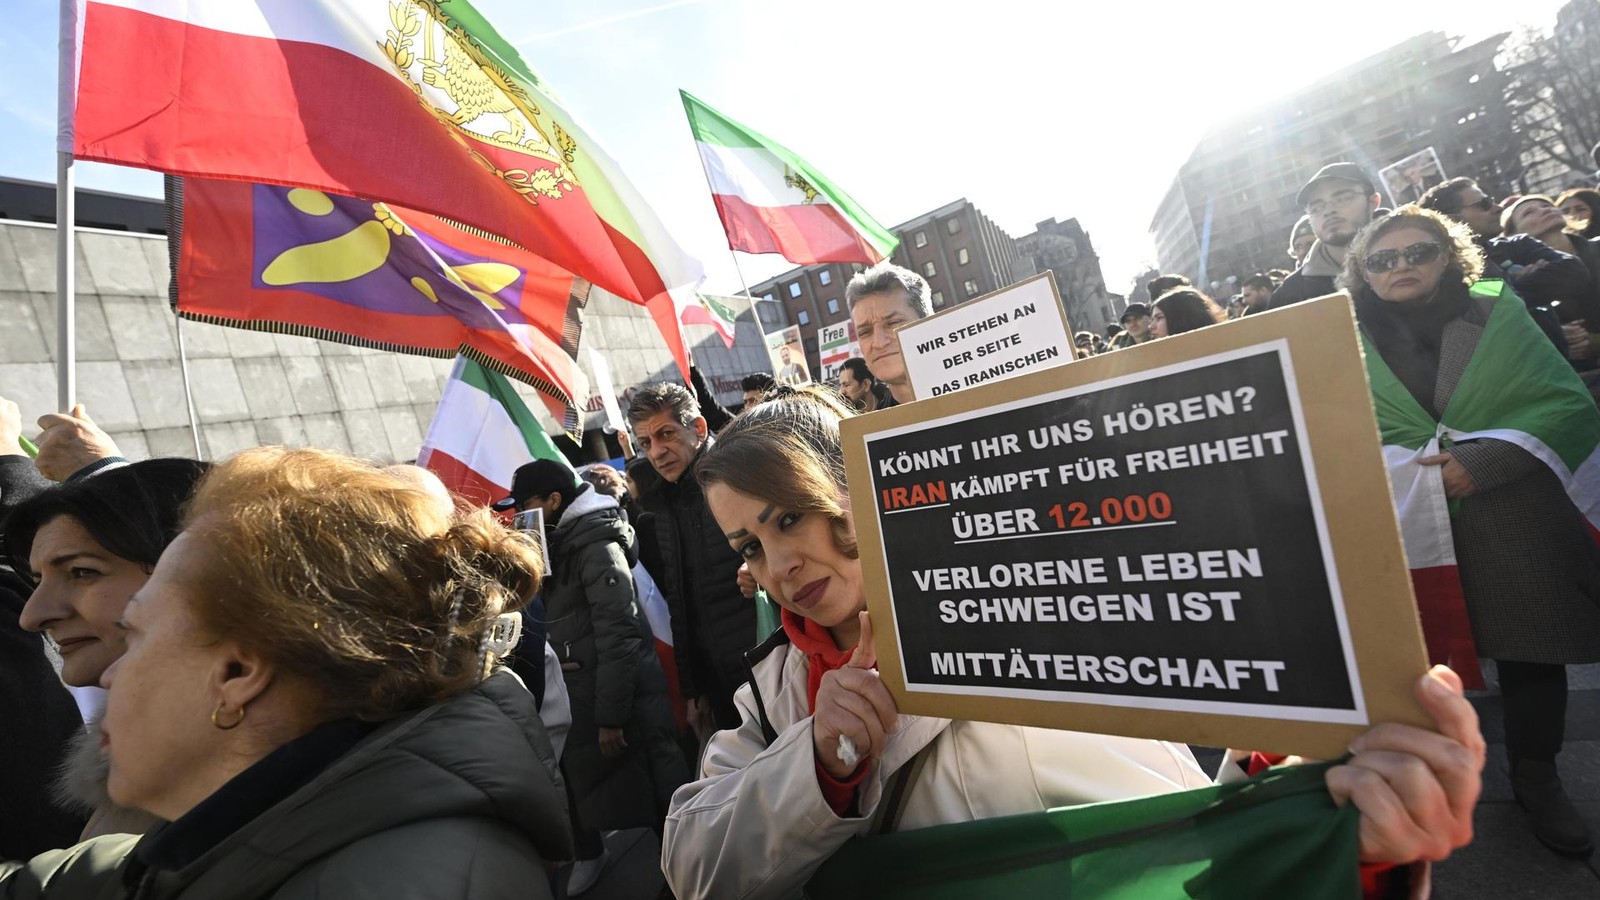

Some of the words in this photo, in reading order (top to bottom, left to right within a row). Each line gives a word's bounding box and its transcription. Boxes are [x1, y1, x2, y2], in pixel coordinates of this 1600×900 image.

[823, 327, 844, 343] Free
[916, 337, 946, 355] WIR
[948, 312, 1009, 343] STEHEN
[1013, 303, 1036, 320] AN
[942, 351, 973, 369] DER
[977, 333, 1022, 357] SEITE
[931, 380, 960, 397] DAS
[964, 346, 1059, 387] IRANISCHEN
[880, 444, 962, 477] KÖNNT
[972, 434, 1019, 461] IHR
[1029, 419, 1094, 450] UNS
[1102, 386, 1256, 437] HÖREN?
[882, 480, 947, 509] IRAN
[951, 468, 1050, 500] KÄMPFT
[1059, 457, 1120, 485] FÜR
[1126, 429, 1289, 475] FREIHEIT
[951, 508, 1040, 539] ÜBER
[1048, 491, 1173, 529] 12.000
[912, 557, 1108, 592] VERLORENE
[1117, 548, 1263, 583] LEBEN
[939, 593, 1154, 623] SCHWEIGEN
[1167, 592, 1241, 622] IST
[930, 647, 1285, 692] MITTÄTERSCHAFT
